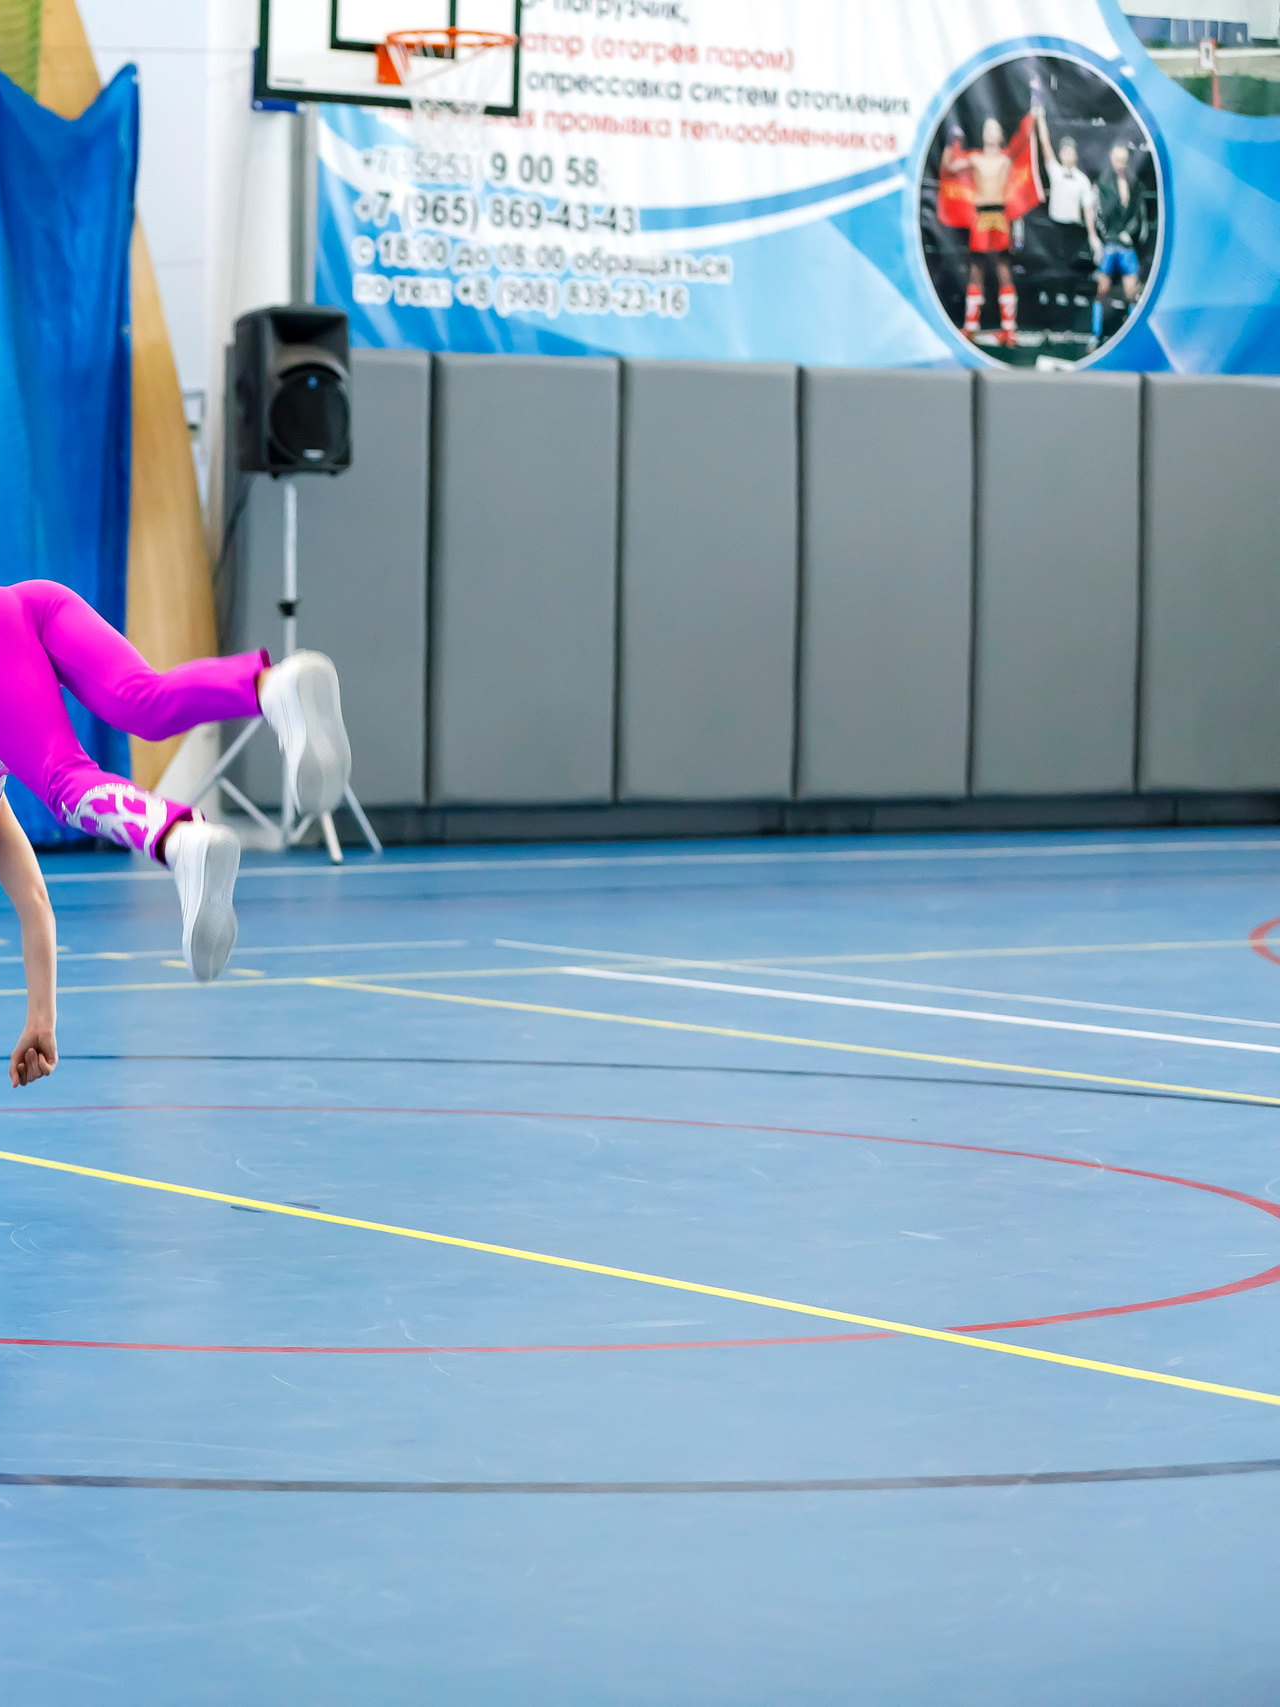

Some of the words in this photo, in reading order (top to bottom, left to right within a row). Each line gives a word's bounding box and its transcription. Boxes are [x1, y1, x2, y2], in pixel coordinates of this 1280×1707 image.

[591, 34, 699, 66] (отогрев
[705, 45, 795, 74] паром)
[526, 70, 683, 102] опрессовка
[688, 80, 779, 108] систем
[785, 87, 911, 116] отопления
[543, 110, 672, 139] промывка
[490, 151, 508, 182] 9
[518, 154, 555, 185] 00
[358, 190, 392, 221] +7
[402, 190, 479, 232] (965)
[489, 197, 636, 235] 869-43-43
